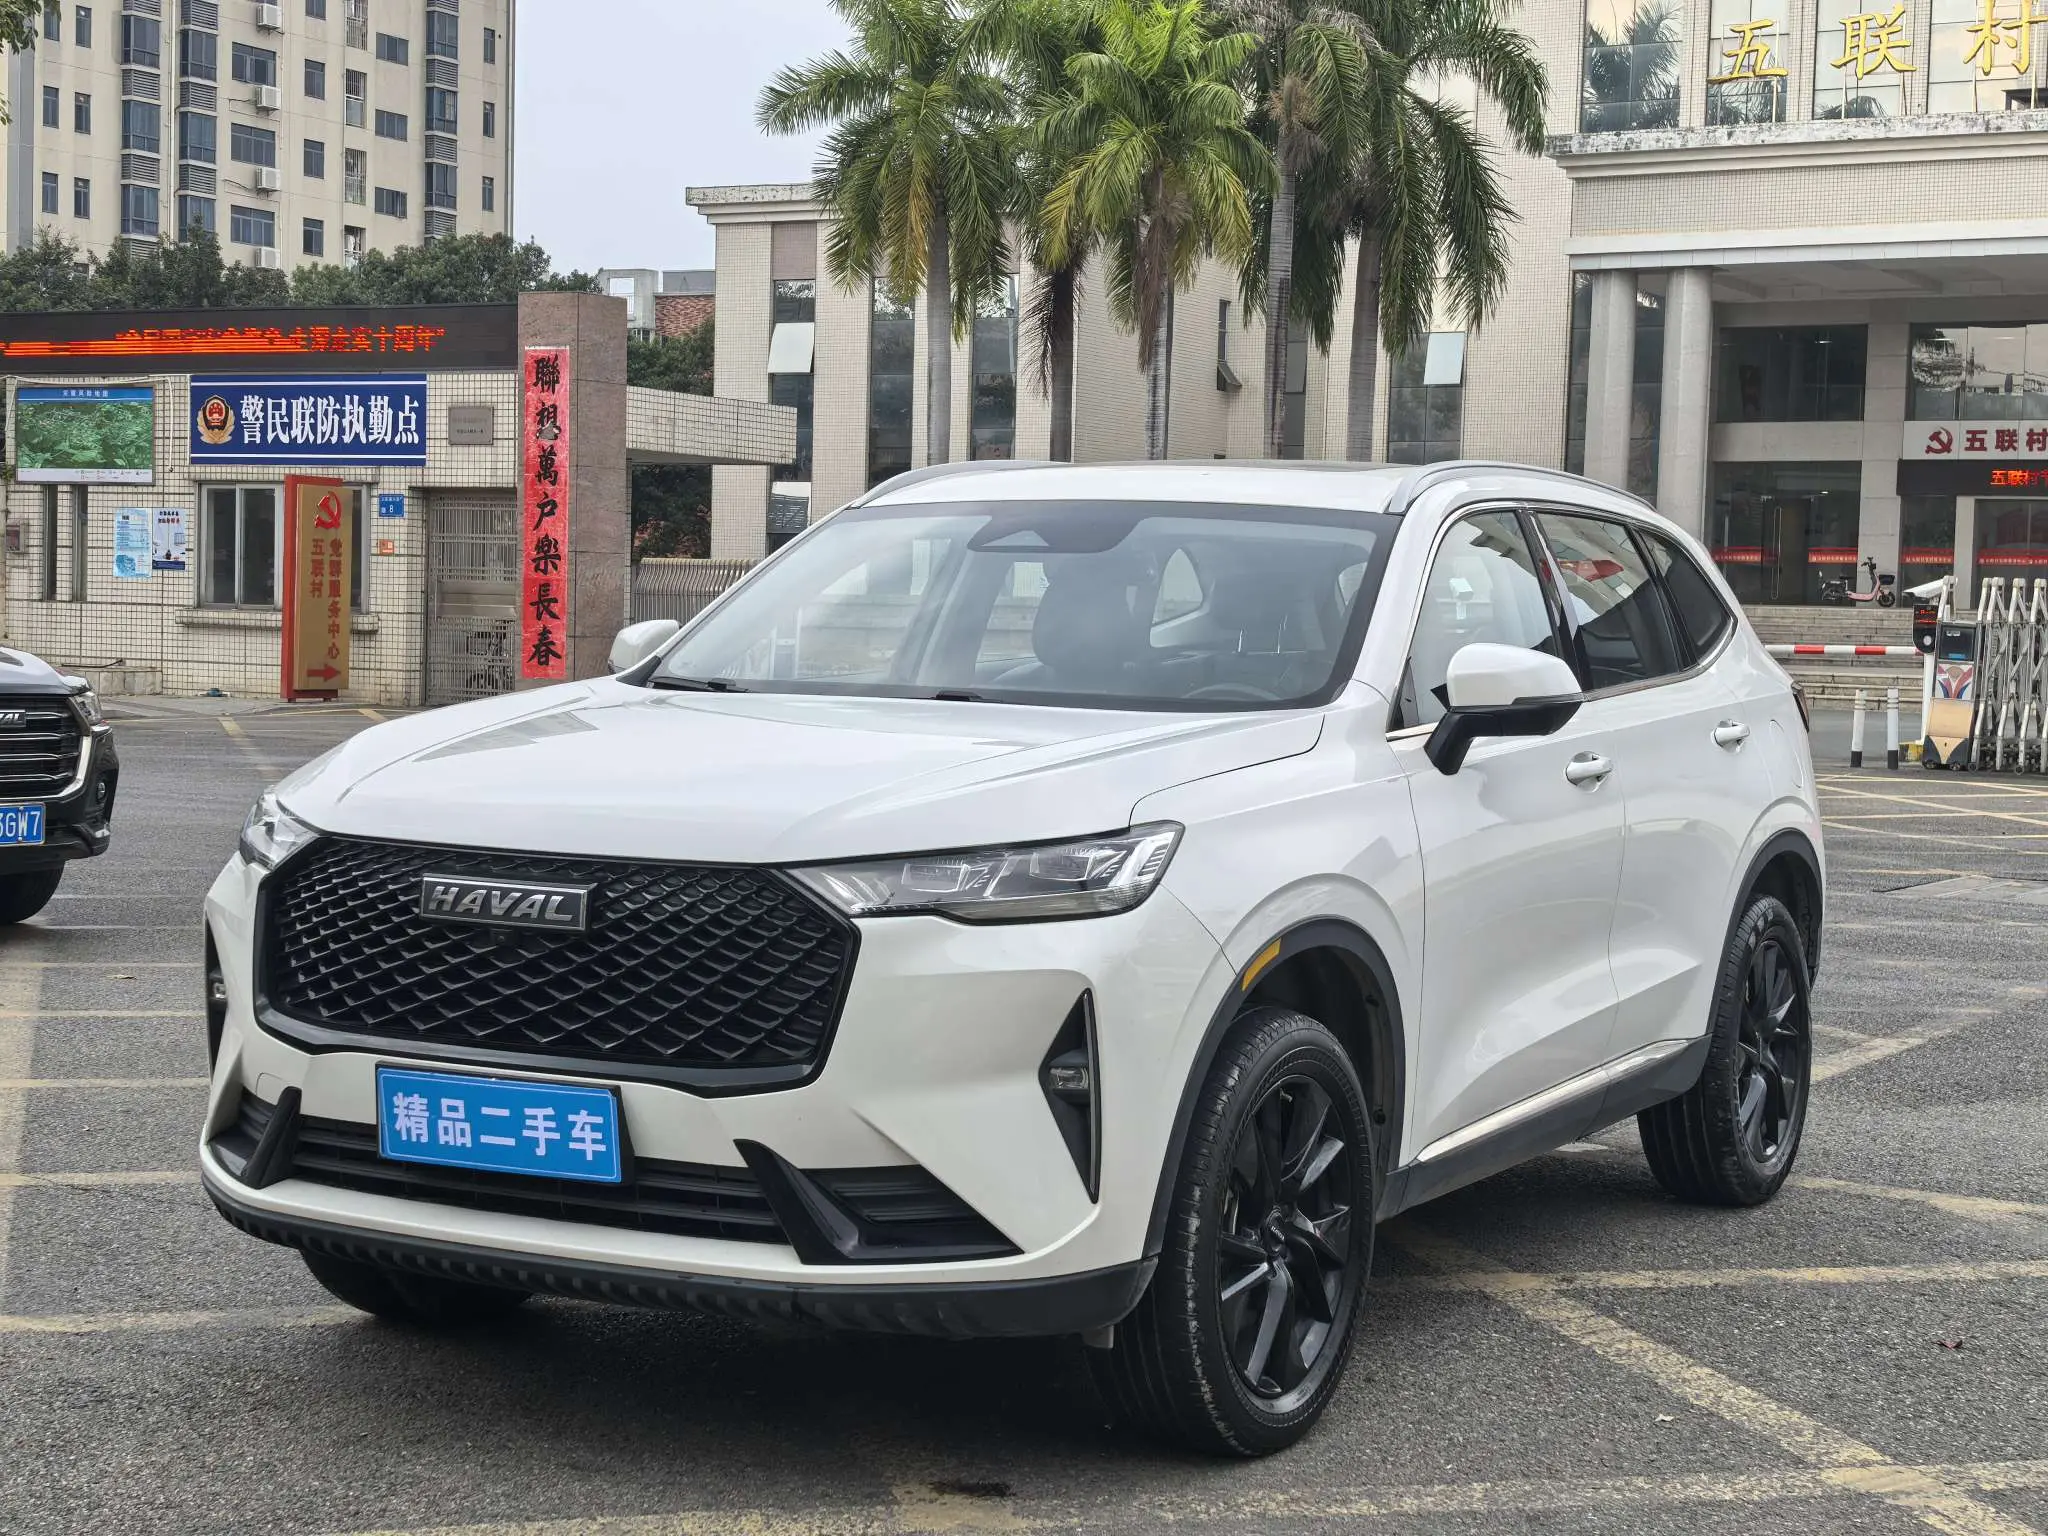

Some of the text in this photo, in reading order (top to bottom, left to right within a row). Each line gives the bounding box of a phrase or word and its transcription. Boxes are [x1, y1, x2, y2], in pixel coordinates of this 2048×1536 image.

[1706, 0, 2048, 81] 五联村
[240, 394, 419, 445] 警民联防执勤点
[1964, 428, 2048, 452] 五联村
[310, 538, 325, 598] 五联村
[328, 538, 343, 659] 党群服务中心
[428, 885, 573, 922] HAVAL
[392, 1091, 607, 1161] 精品二手车
